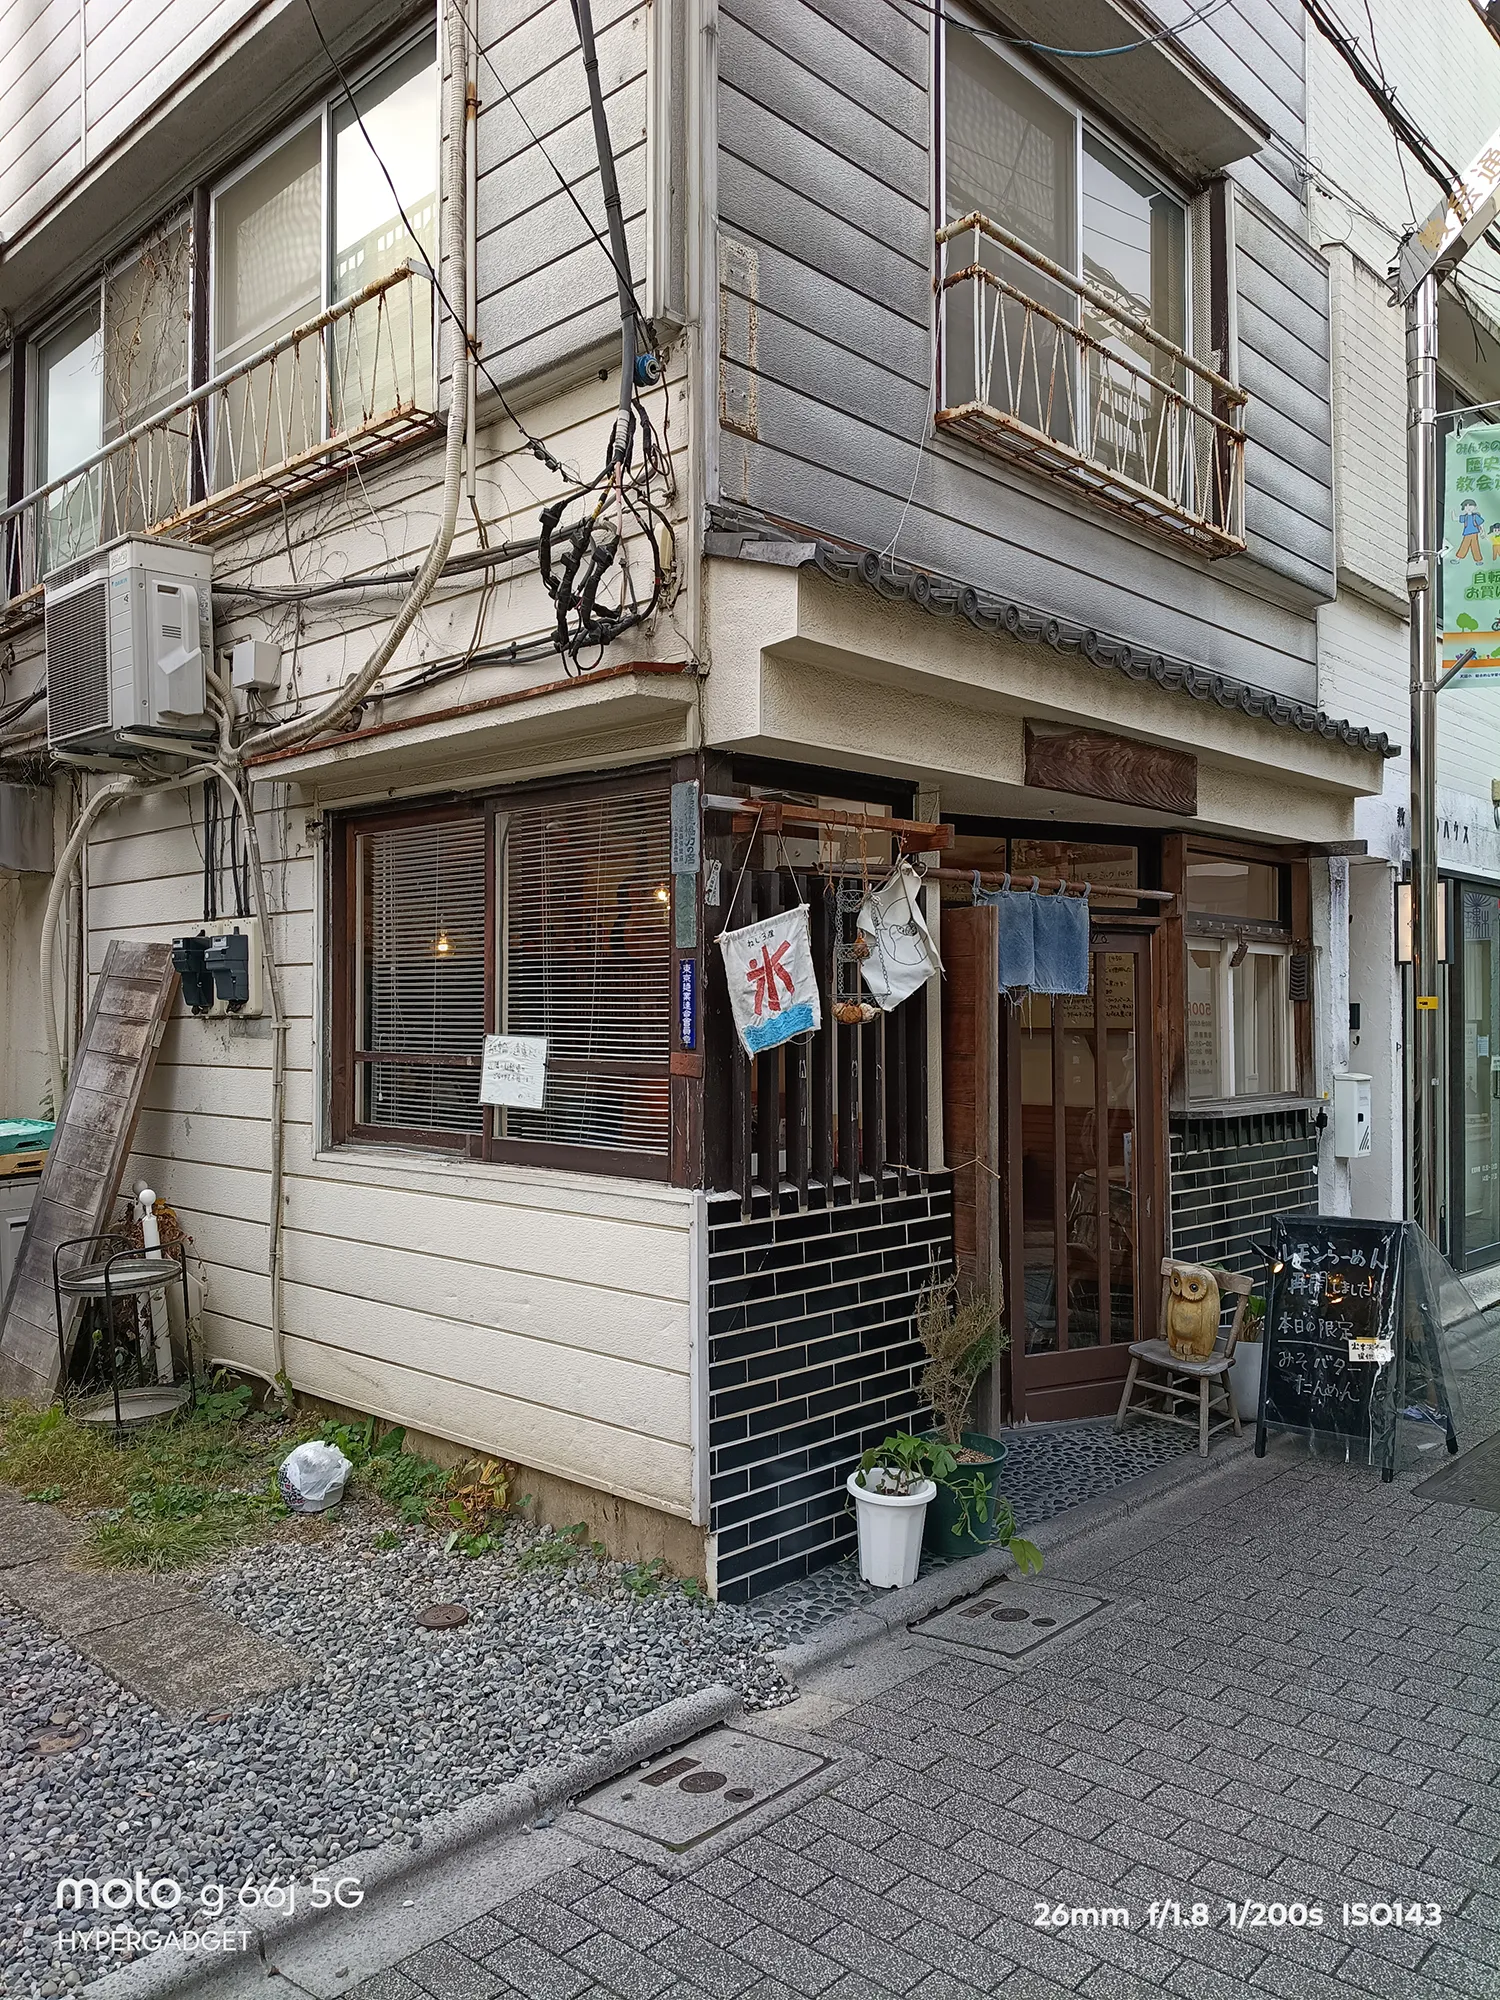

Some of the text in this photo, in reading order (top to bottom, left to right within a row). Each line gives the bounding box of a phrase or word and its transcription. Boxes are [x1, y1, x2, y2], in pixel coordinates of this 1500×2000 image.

[1456, 440, 1500, 454] みんなの
[1466, 456, 1500, 474] 歴史
[1437, 816, 1469, 844] ハウス
[746, 940, 794, 1016] 氷
[1282, 1241, 1389, 1270] レモンらーめん
[1278, 1312, 1354, 1341] 本日の限定
[1295, 1374, 1360, 1402] たんめん
